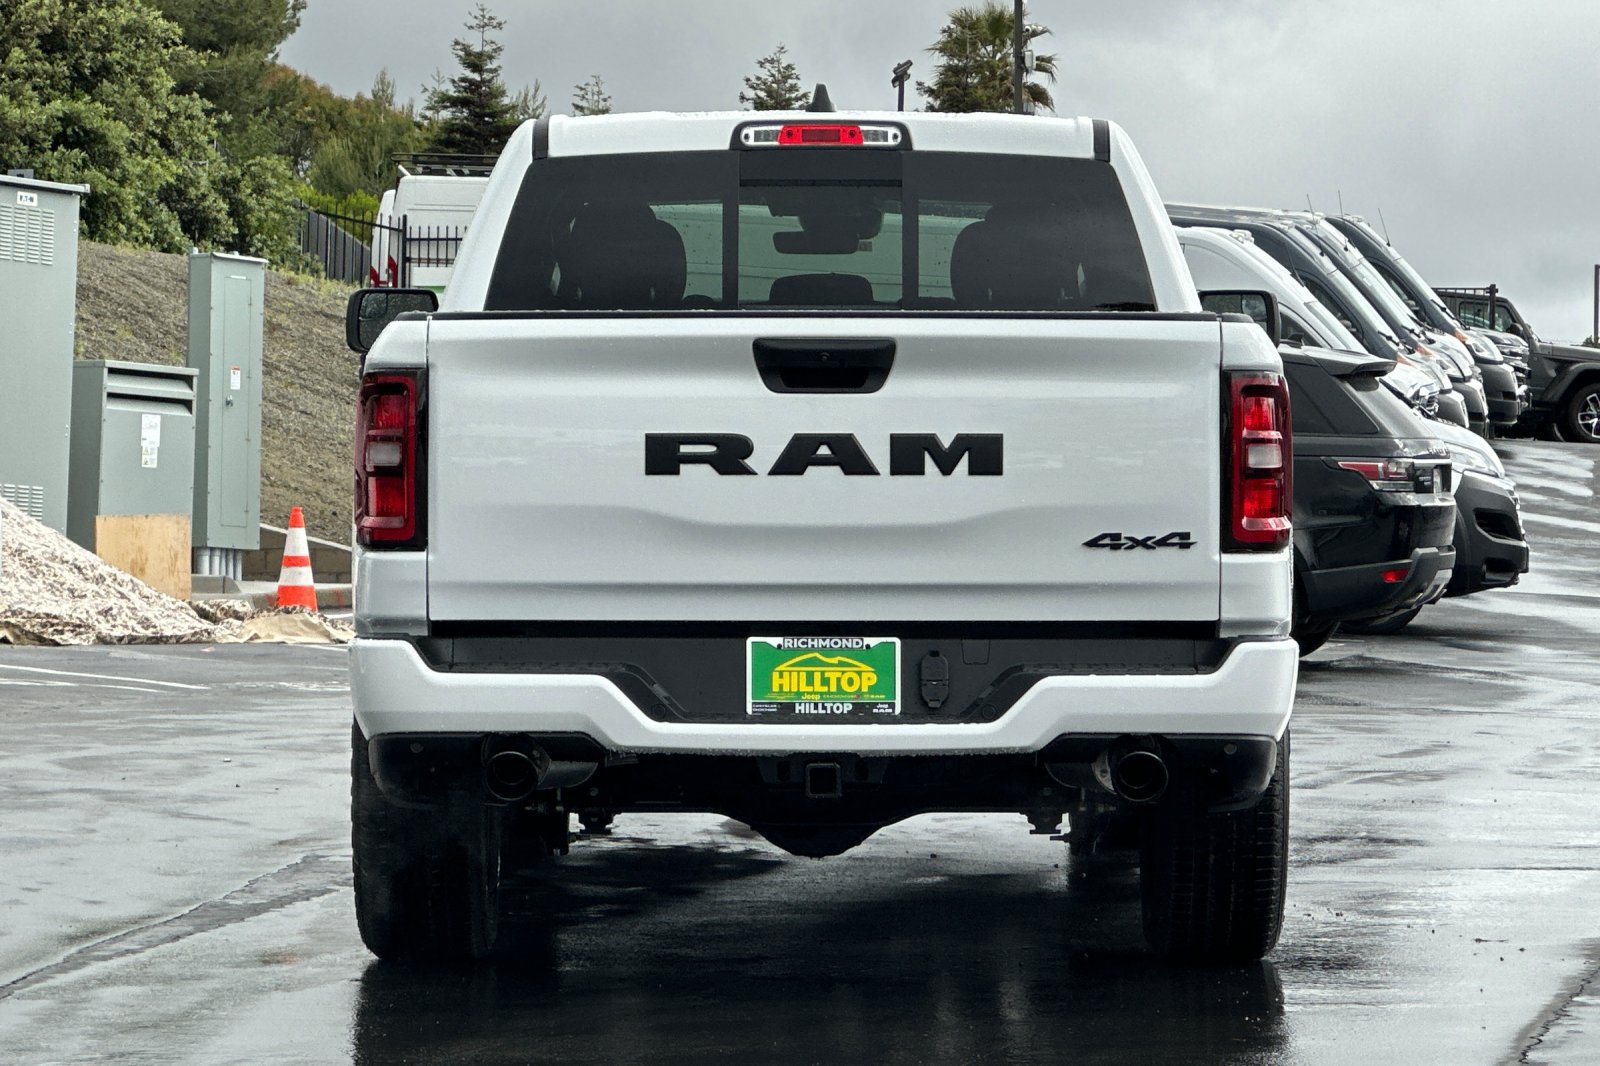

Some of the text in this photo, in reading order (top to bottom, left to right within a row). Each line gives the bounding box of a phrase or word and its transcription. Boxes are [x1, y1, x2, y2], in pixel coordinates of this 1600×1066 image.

[645, 433, 1004, 476] RAM
[1081, 532, 1198, 550] 4x4
[784, 638, 863, 649] RICHMOND
[772, 671, 878, 692] HILLTOP
[795, 703, 853, 714] HILLTOP
